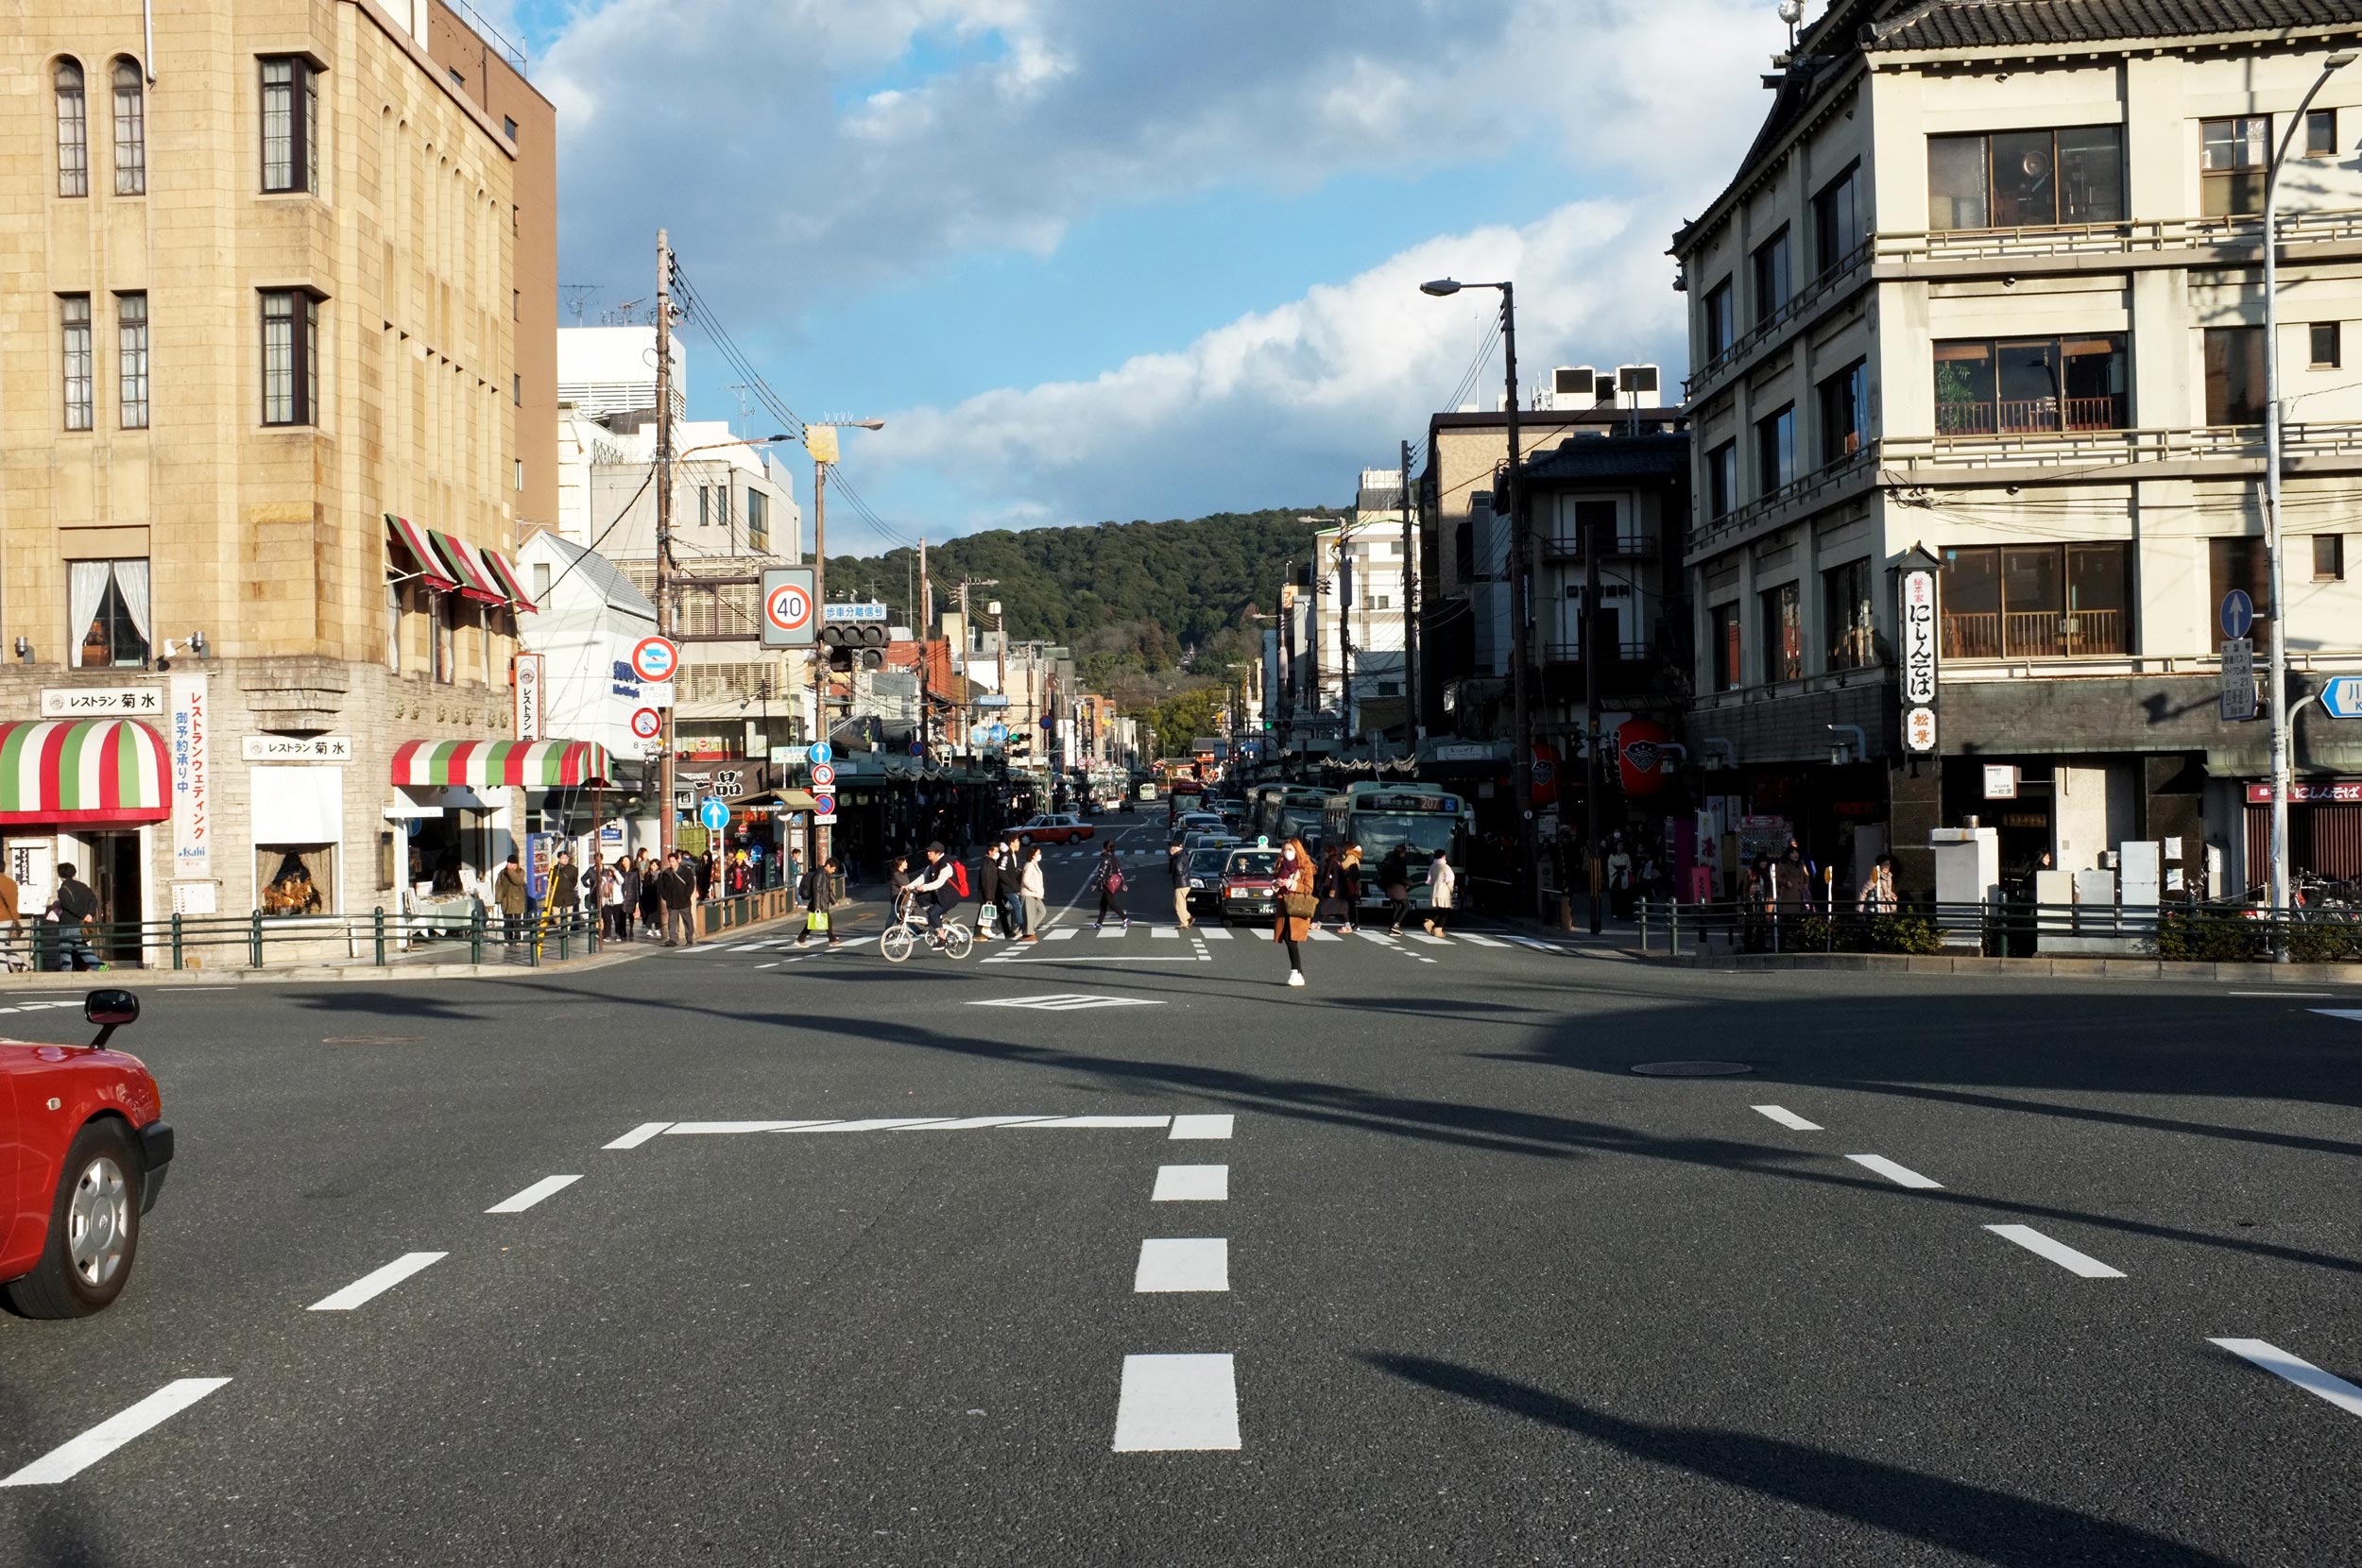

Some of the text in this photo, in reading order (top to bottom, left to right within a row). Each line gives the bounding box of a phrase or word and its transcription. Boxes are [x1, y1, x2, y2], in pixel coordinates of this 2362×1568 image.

[777, 597, 801, 617] 40
[826, 605, 883, 617] 歩車分離信号
[1909, 605, 1932, 696] にしんそば
[1913, 714, 1929, 743] 松葉
[176, 712, 188, 793] 御予約承り中
[192, 692, 205, 839] レストランウェディング
[2294, 786, 2360, 799] にしんそば
[1421, 798, 1440, 810] 207
[179, 846, 205, 857] Asahi
